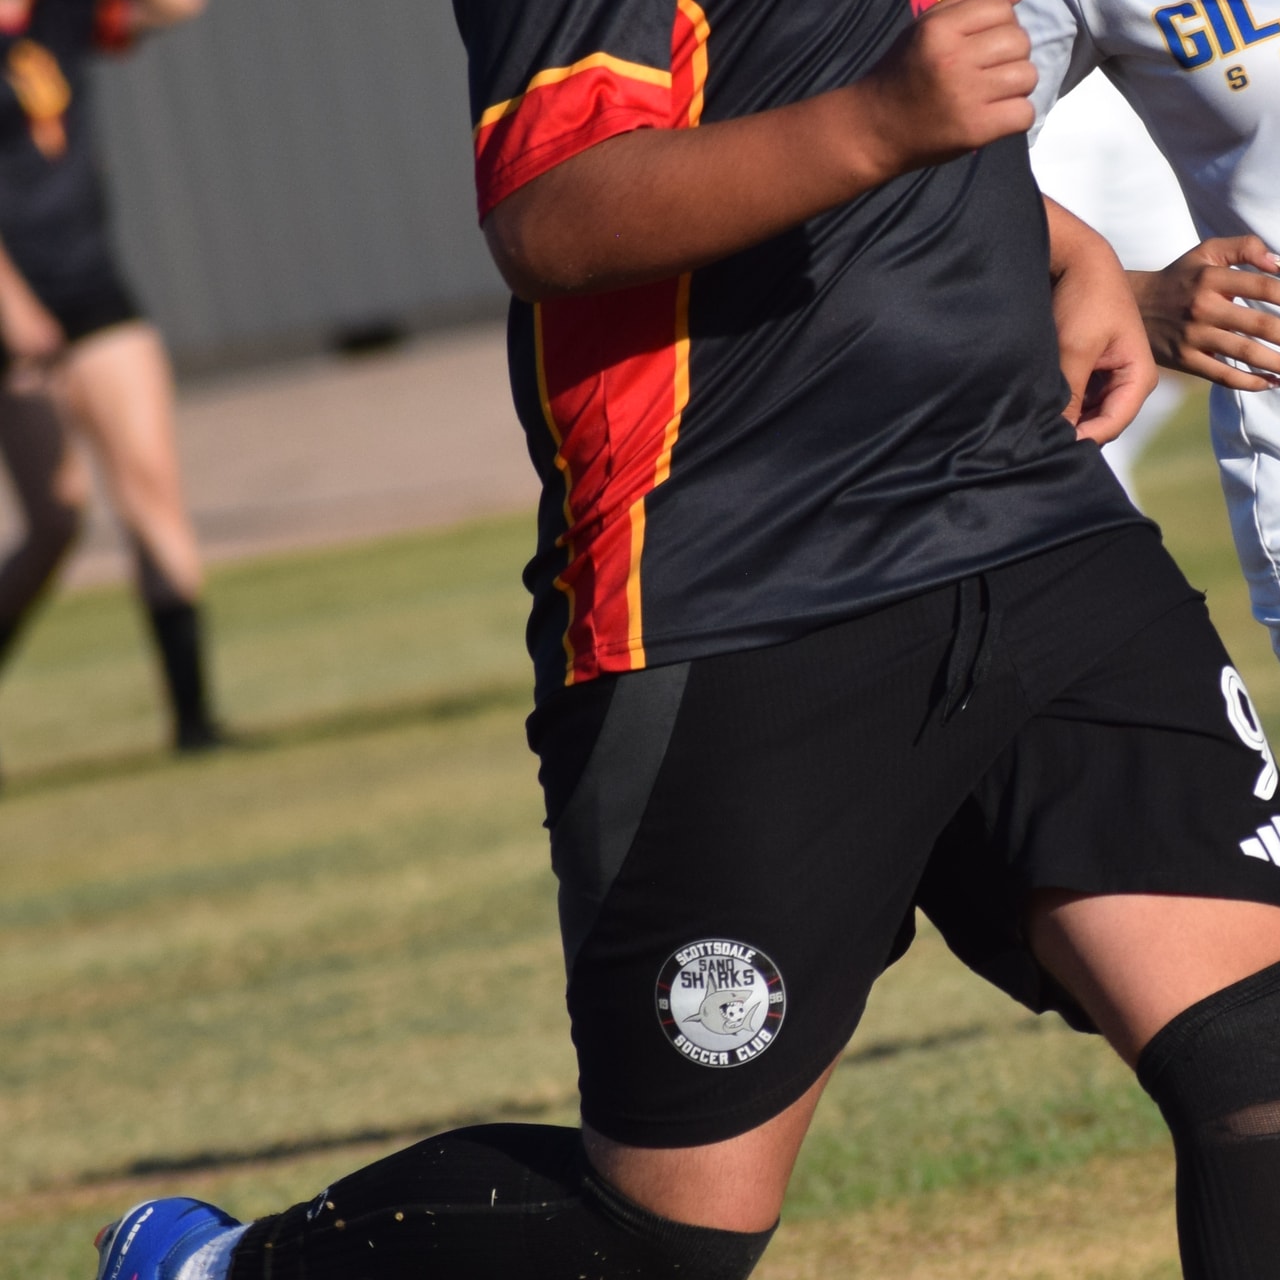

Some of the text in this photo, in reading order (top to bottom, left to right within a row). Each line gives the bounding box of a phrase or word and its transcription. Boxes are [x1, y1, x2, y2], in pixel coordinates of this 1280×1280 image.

[1221, 665, 1279, 801] 9
[675, 942, 756, 967] SCOTTSDALE
[698, 958, 735, 972] SAND
[681, 969, 755, 989] SHARKS
[674, 1029, 772, 1065] SOCCER CLUB
